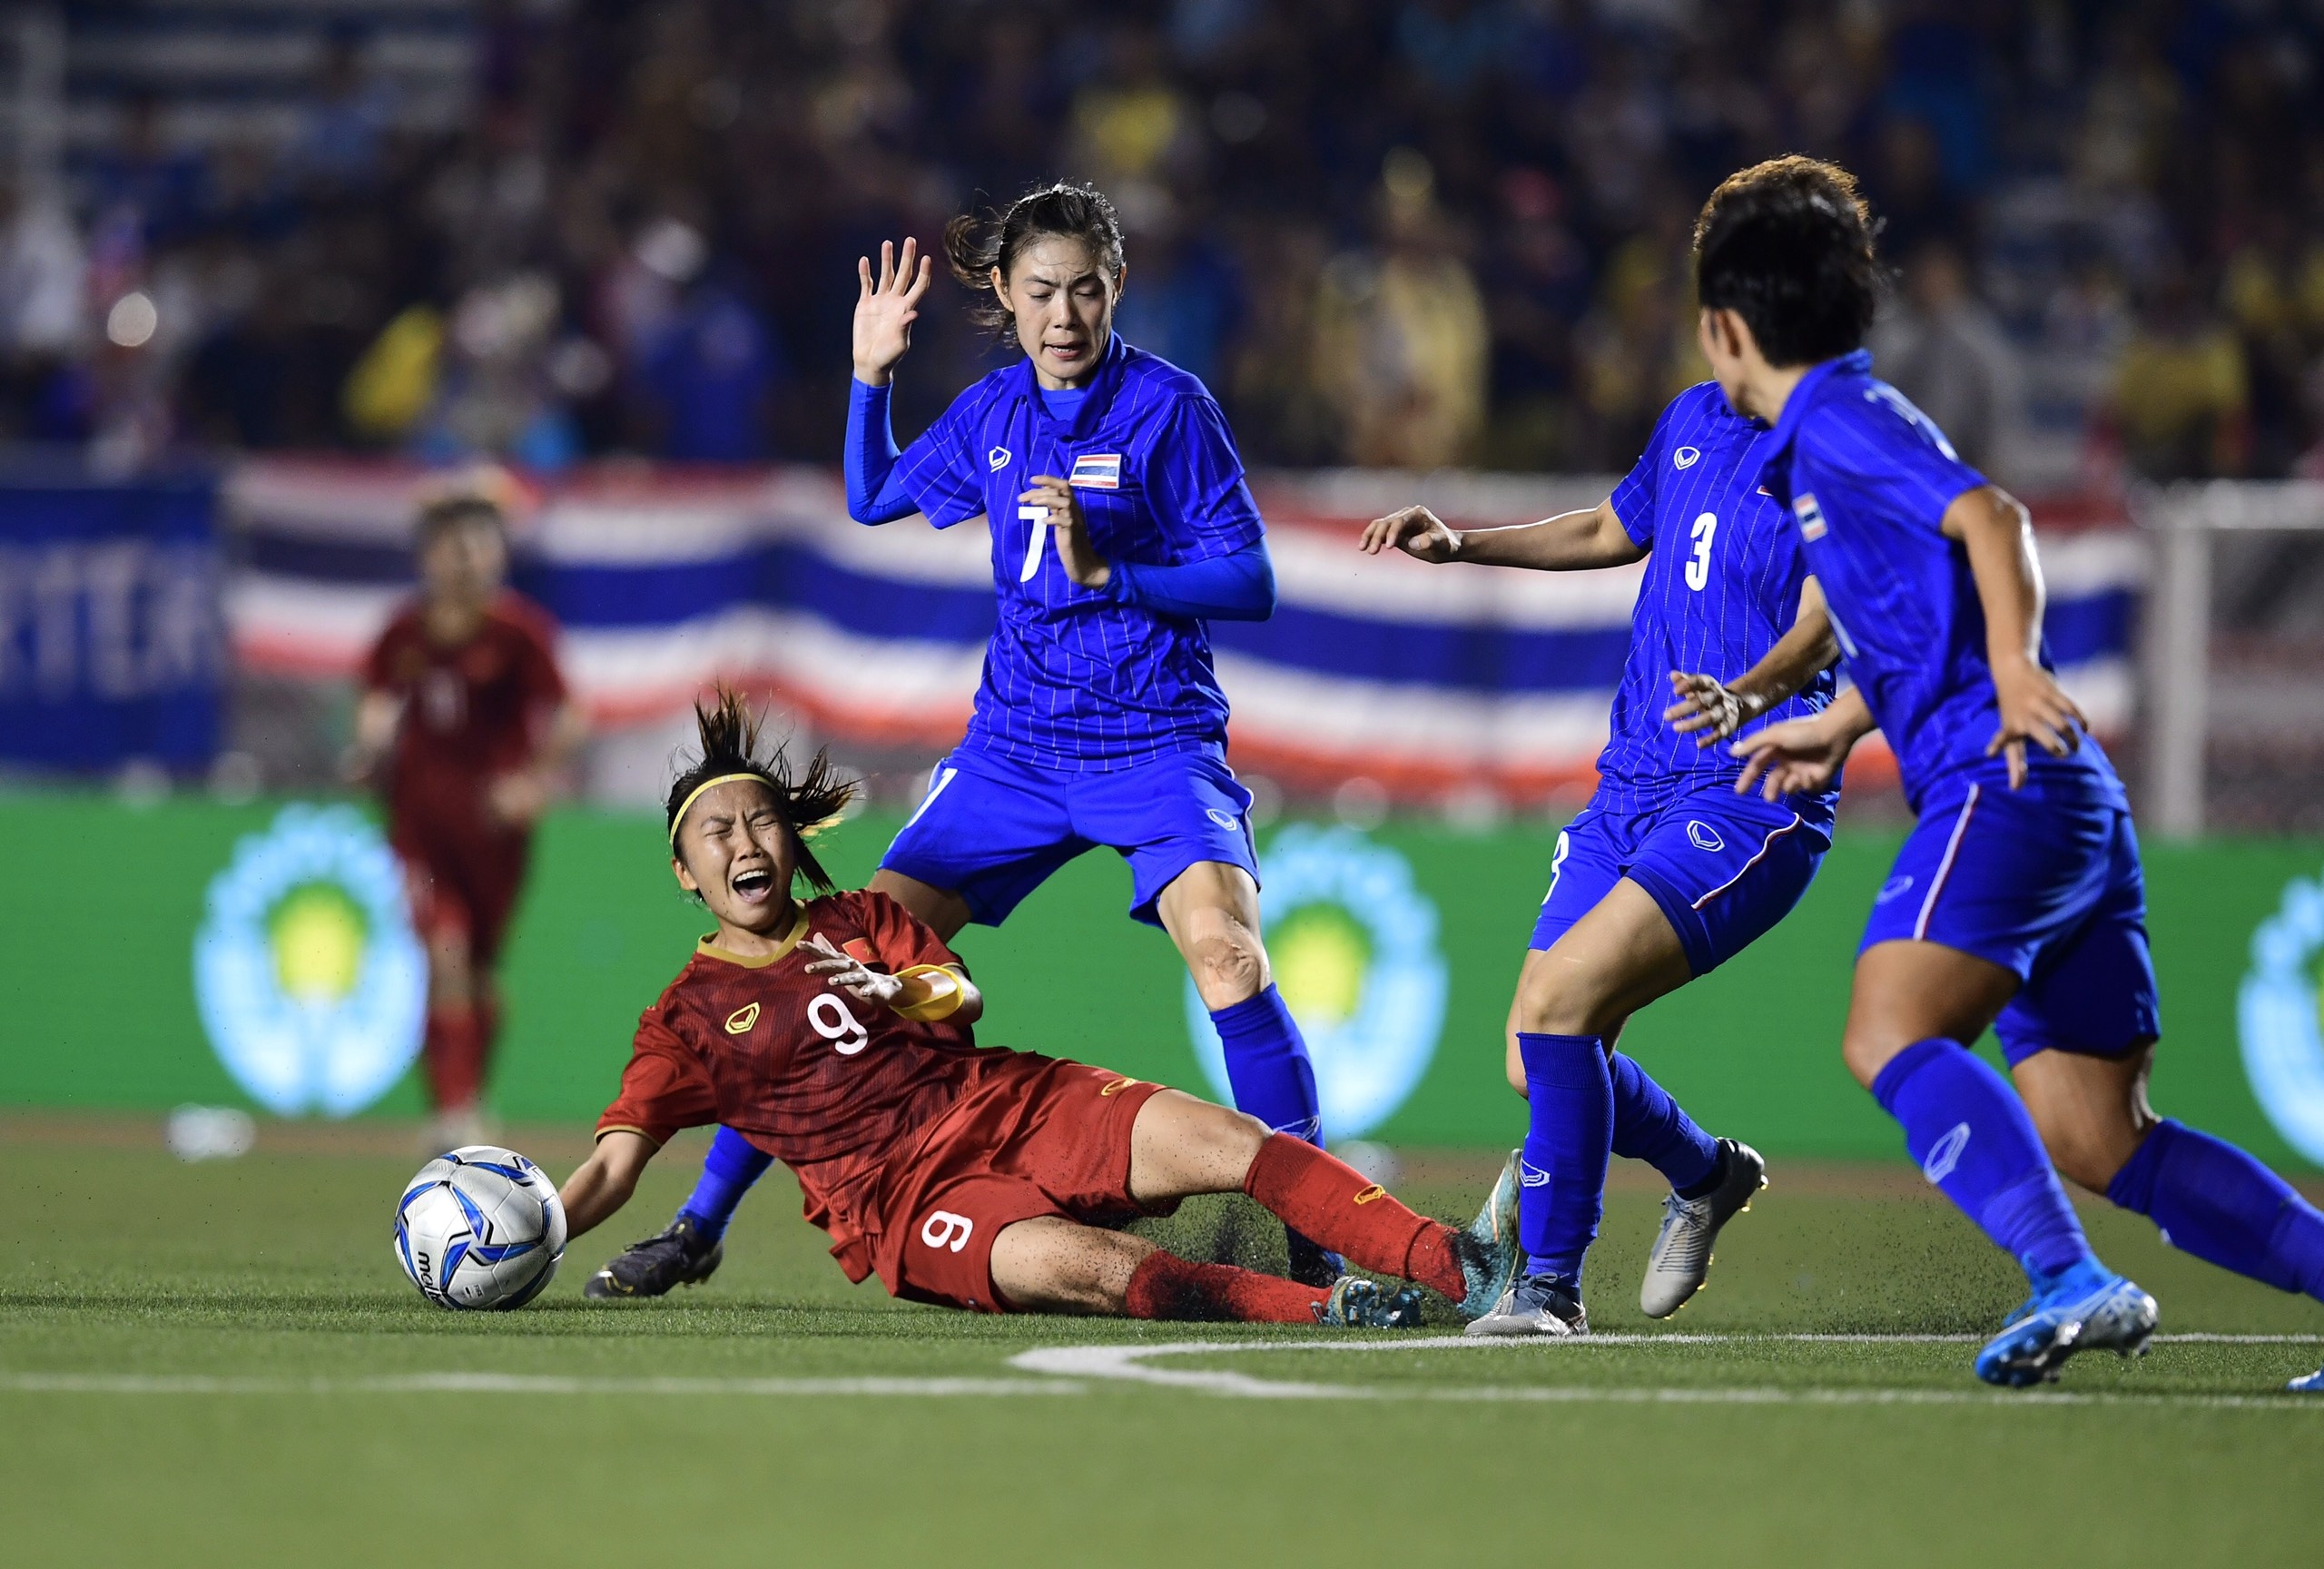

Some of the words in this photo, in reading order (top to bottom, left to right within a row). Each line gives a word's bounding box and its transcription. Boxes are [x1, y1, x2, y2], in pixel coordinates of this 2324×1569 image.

[1018, 506, 1049, 583] 7
[1685, 511, 1718, 592] 3
[807, 992, 869, 1055] 9
[921, 1209, 974, 1253] 9
